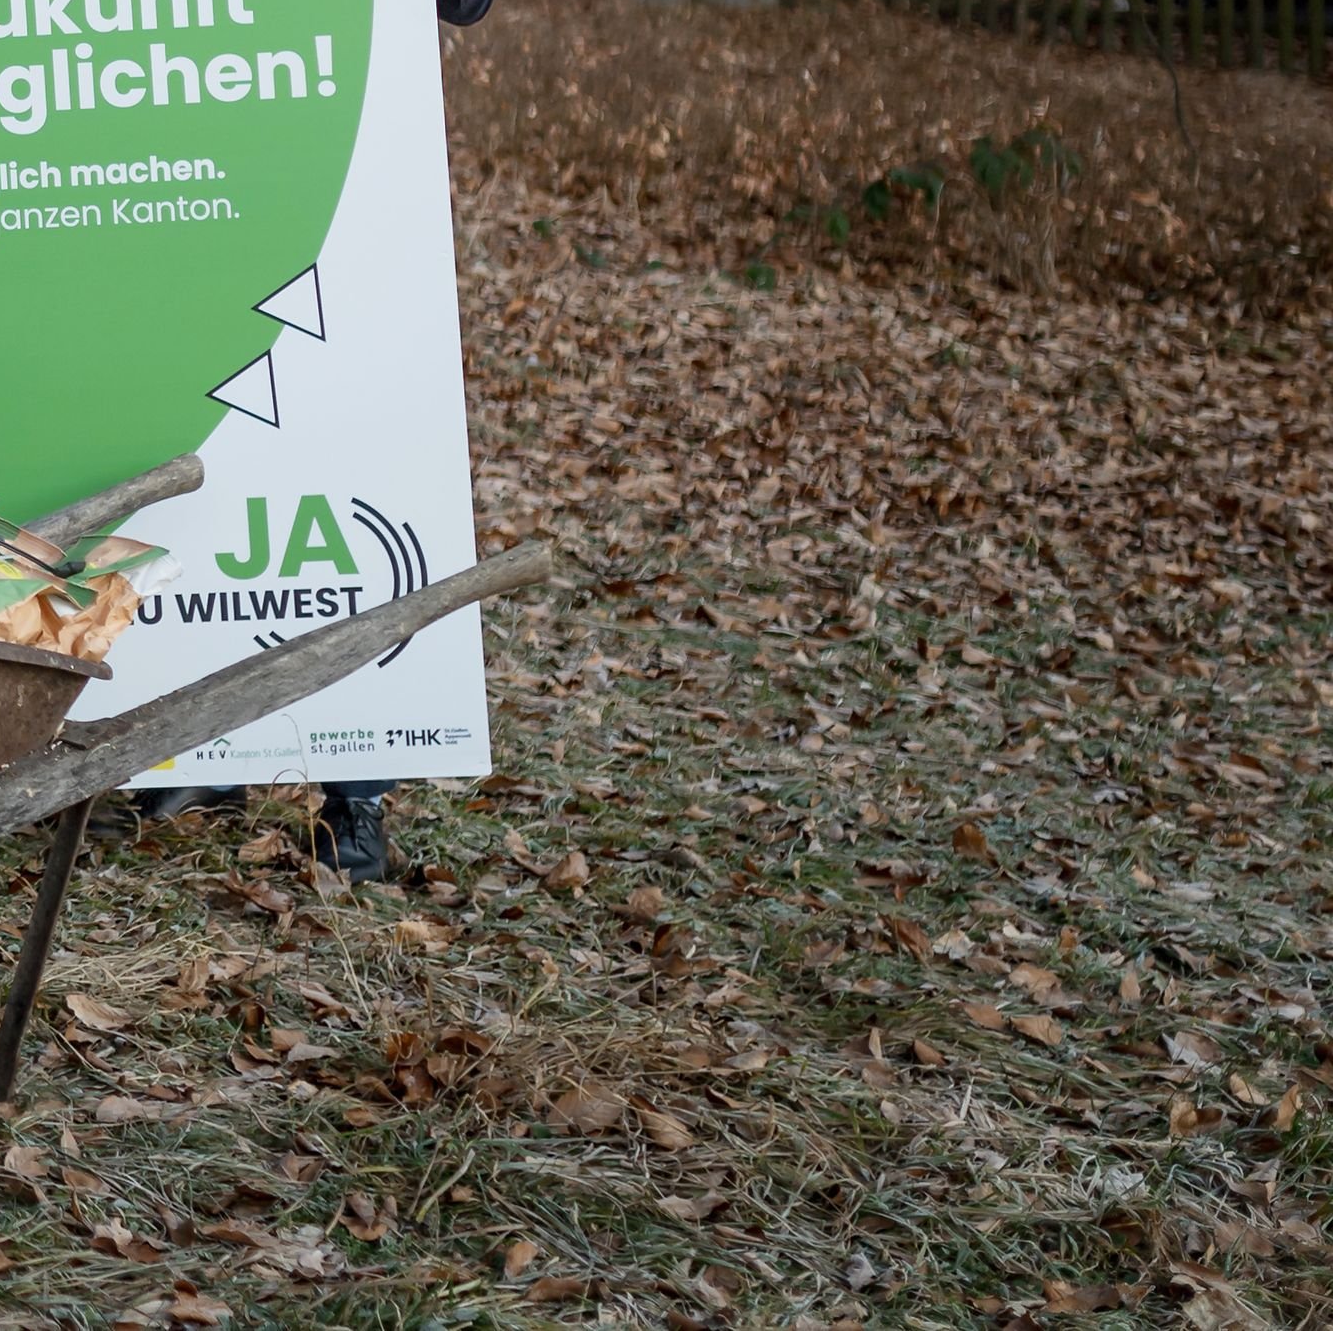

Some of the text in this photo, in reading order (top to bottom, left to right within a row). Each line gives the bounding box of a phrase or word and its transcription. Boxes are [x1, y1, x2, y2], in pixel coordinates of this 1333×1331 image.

[70, 155, 227, 187] machen.
[112, 195, 241, 226] Kanton.
[215, 494, 360, 580] JA
[130, 586, 363, 625] U WILWEST
[310, 729, 374, 743] gewerbe
[310, 741, 375, 756] st.gallen
[405, 728, 441, 746] IHK
